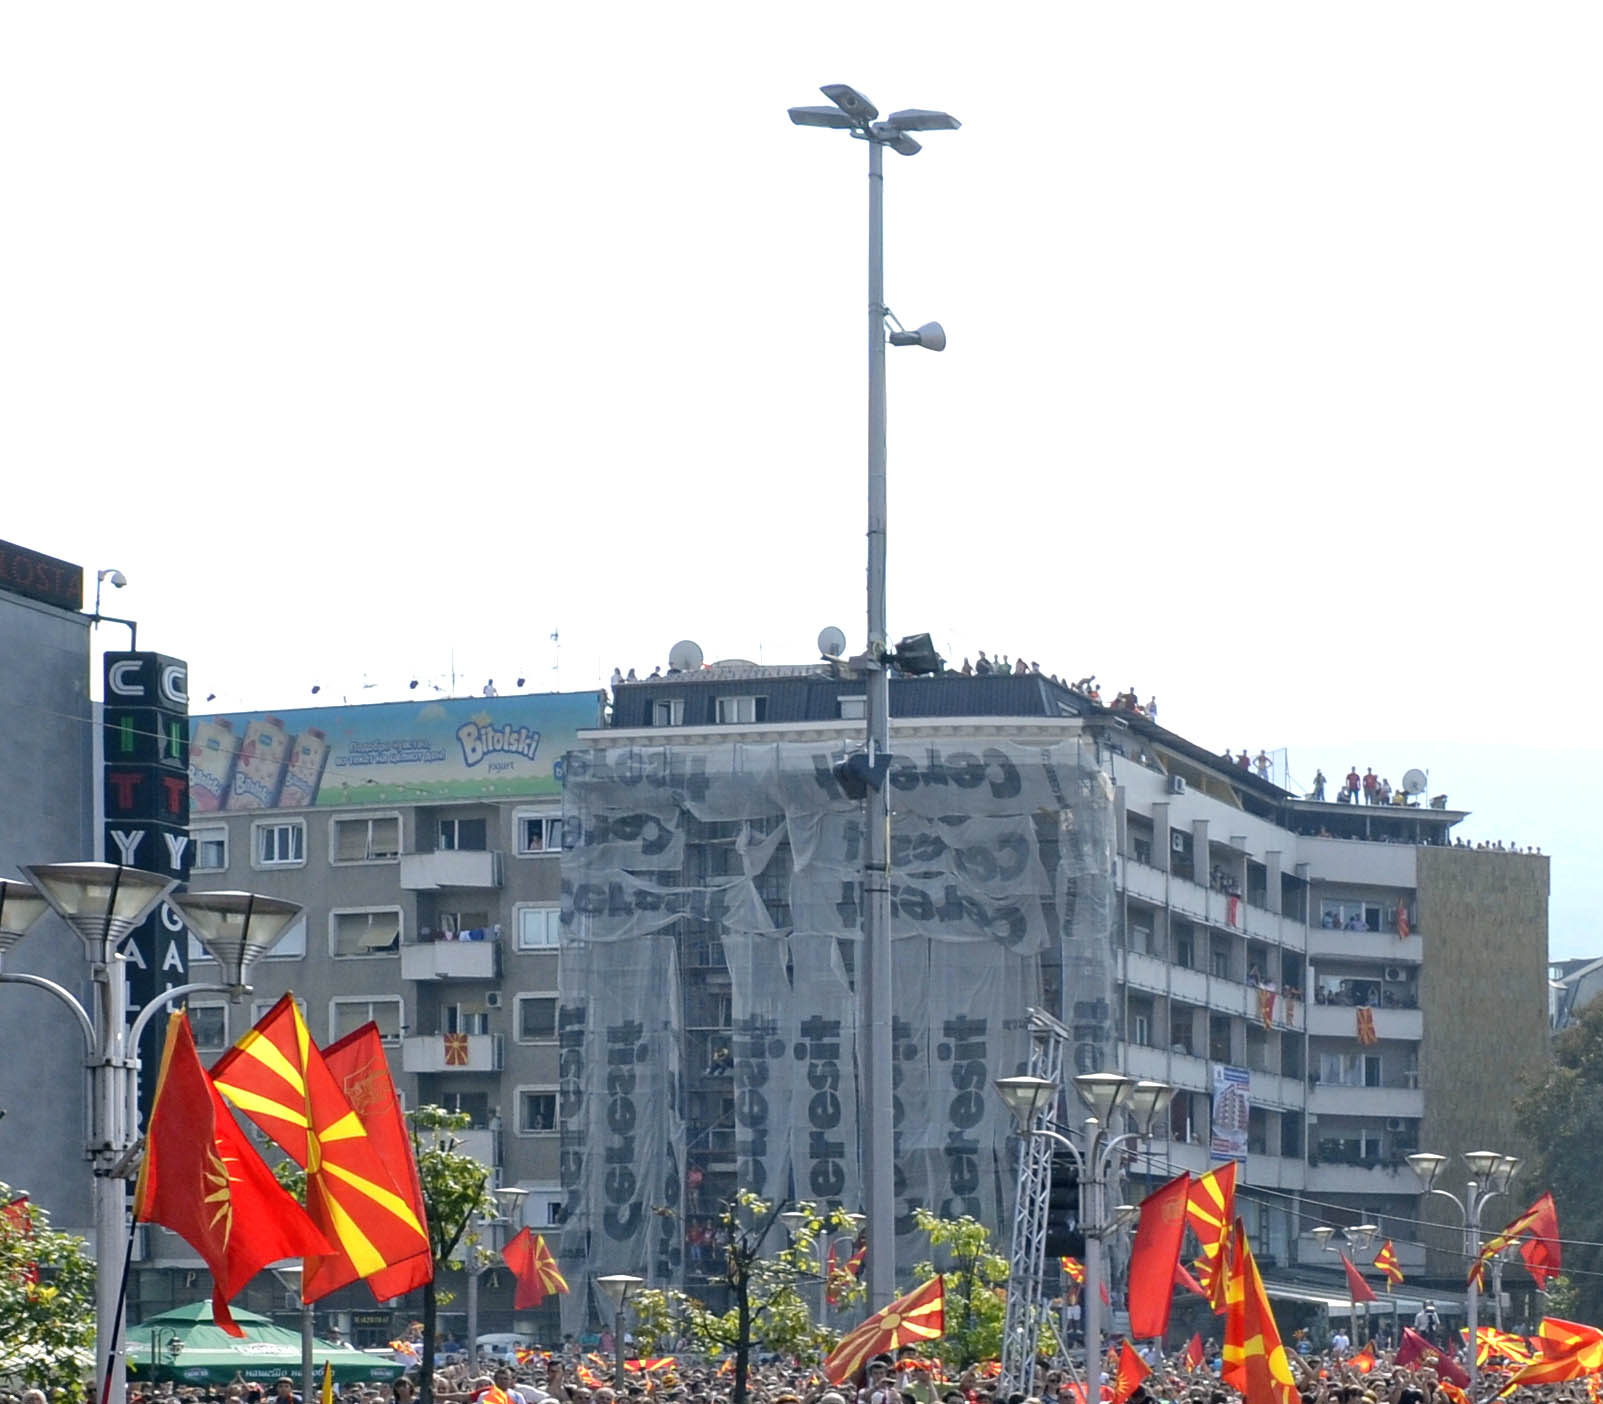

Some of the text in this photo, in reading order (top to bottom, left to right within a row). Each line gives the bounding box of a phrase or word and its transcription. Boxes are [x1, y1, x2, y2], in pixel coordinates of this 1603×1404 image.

[108, 660, 144, 866] CITY
[161, 665, 190, 871] CITY
[458, 722, 541, 767] Bitolski
